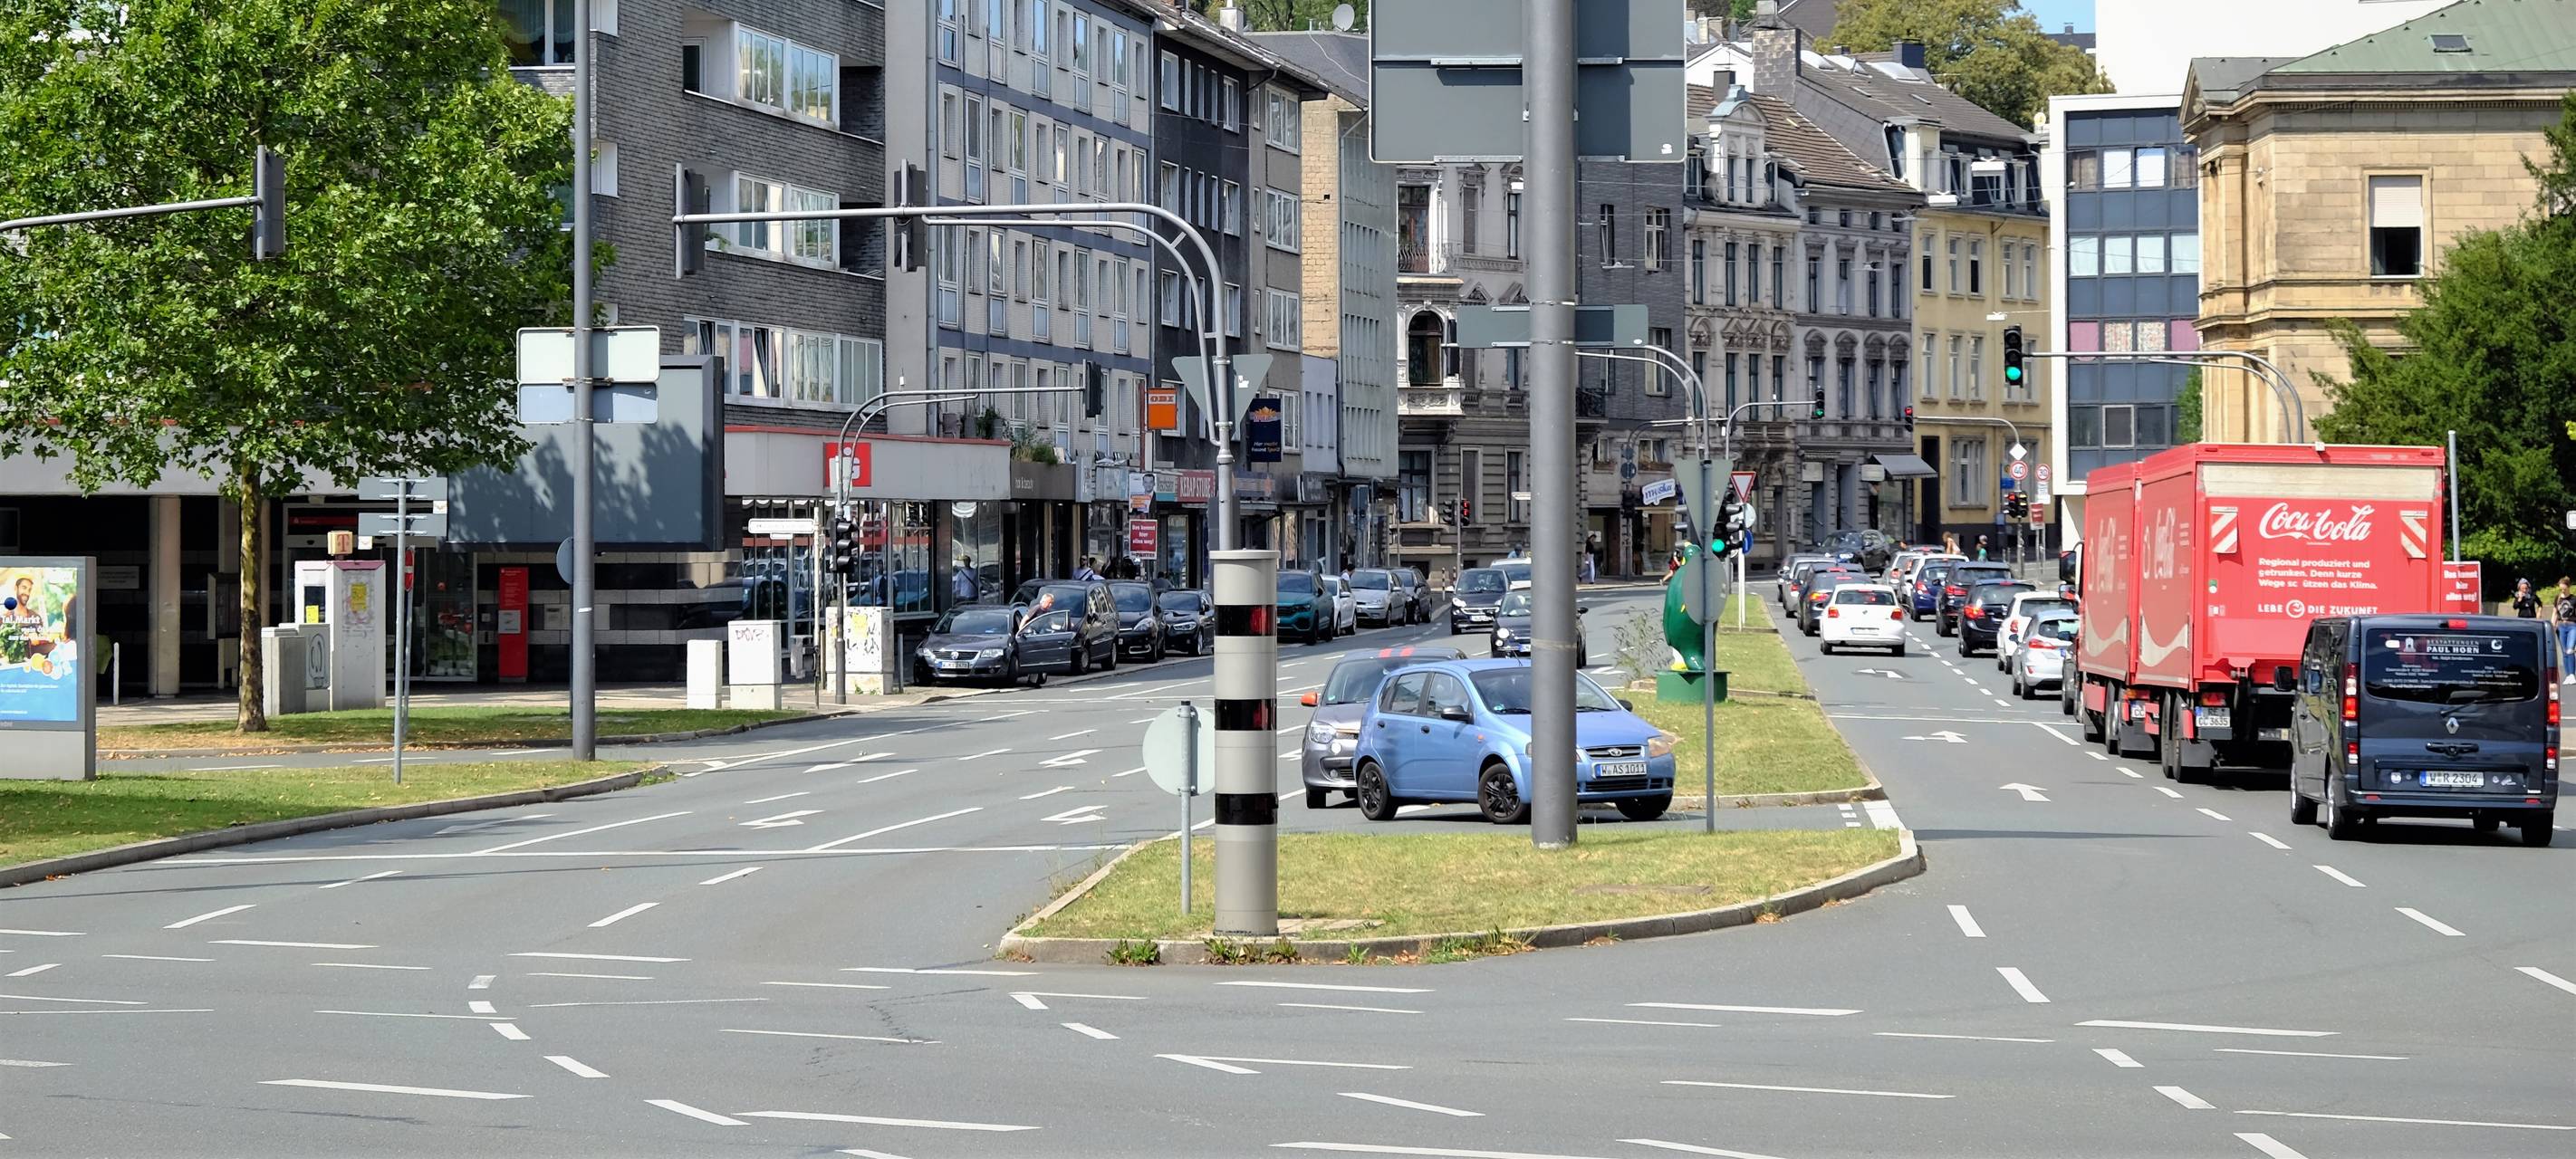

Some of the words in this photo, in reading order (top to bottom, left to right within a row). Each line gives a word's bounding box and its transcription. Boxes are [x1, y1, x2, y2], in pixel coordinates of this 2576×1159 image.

[1149, 395, 1175, 403] OBI
[2259, 502, 2375, 541] Coca-Cola
[336, 533, 351, 552] T
[2258, 558, 2300, 568] Regional
[2302, 559, 2350, 569] produziert
[2352, 560, 2369, 568] und
[2258, 569, 2308, 578] getrunken.
[2310, 570, 2334, 578] Denn
[2337, 570, 2362, 578] kurze
[2258, 579, 2285, 588] Wege
[2350, 580, 2378, 589] Klima.
[2258, 604, 2283, 612] LEBE
[2308, 605, 2325, 614] DIE
[2330, 606, 2378, 615] ZUKUNFT
[2429, 772, 2436, 781] W
[2444, 772, 2449, 782] R
[2452, 773, 2477, 783] 2304
